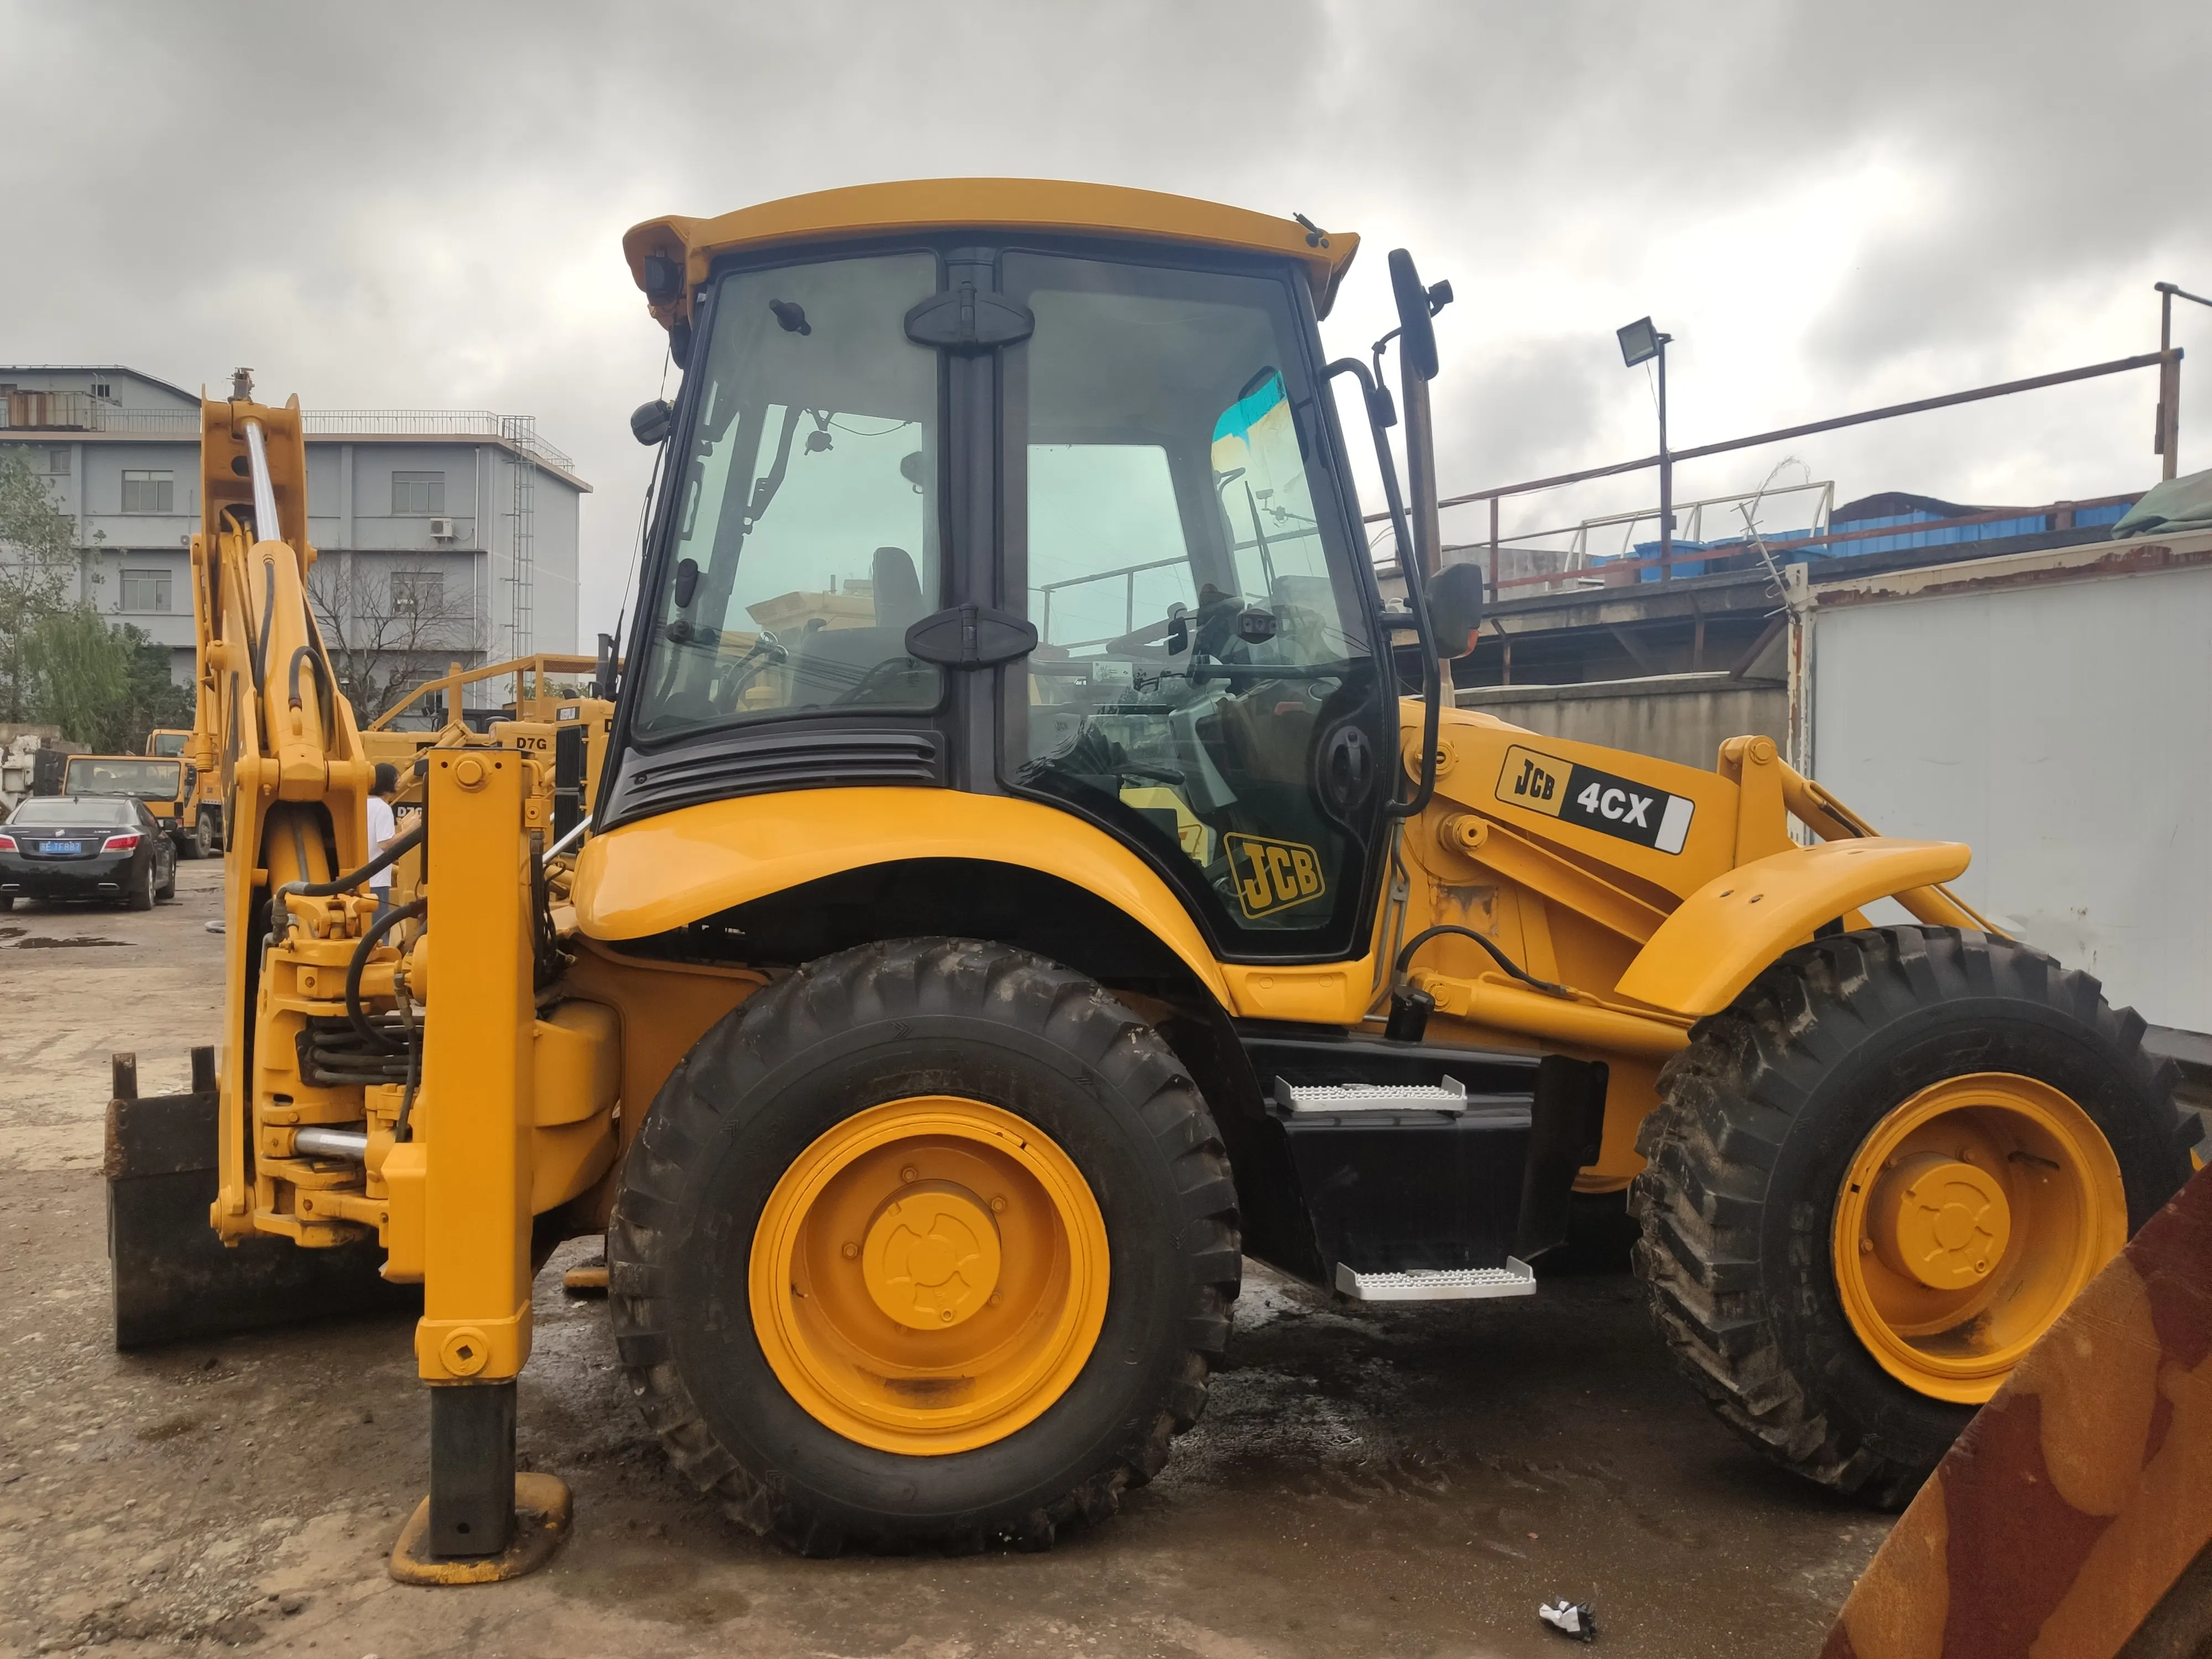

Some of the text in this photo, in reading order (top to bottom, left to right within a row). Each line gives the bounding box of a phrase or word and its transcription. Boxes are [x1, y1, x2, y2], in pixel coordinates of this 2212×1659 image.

[517, 737, 547, 750] D7G
[1514, 758, 1654, 828] JCB 4CX
[1242, 842, 1318, 909] JCB
